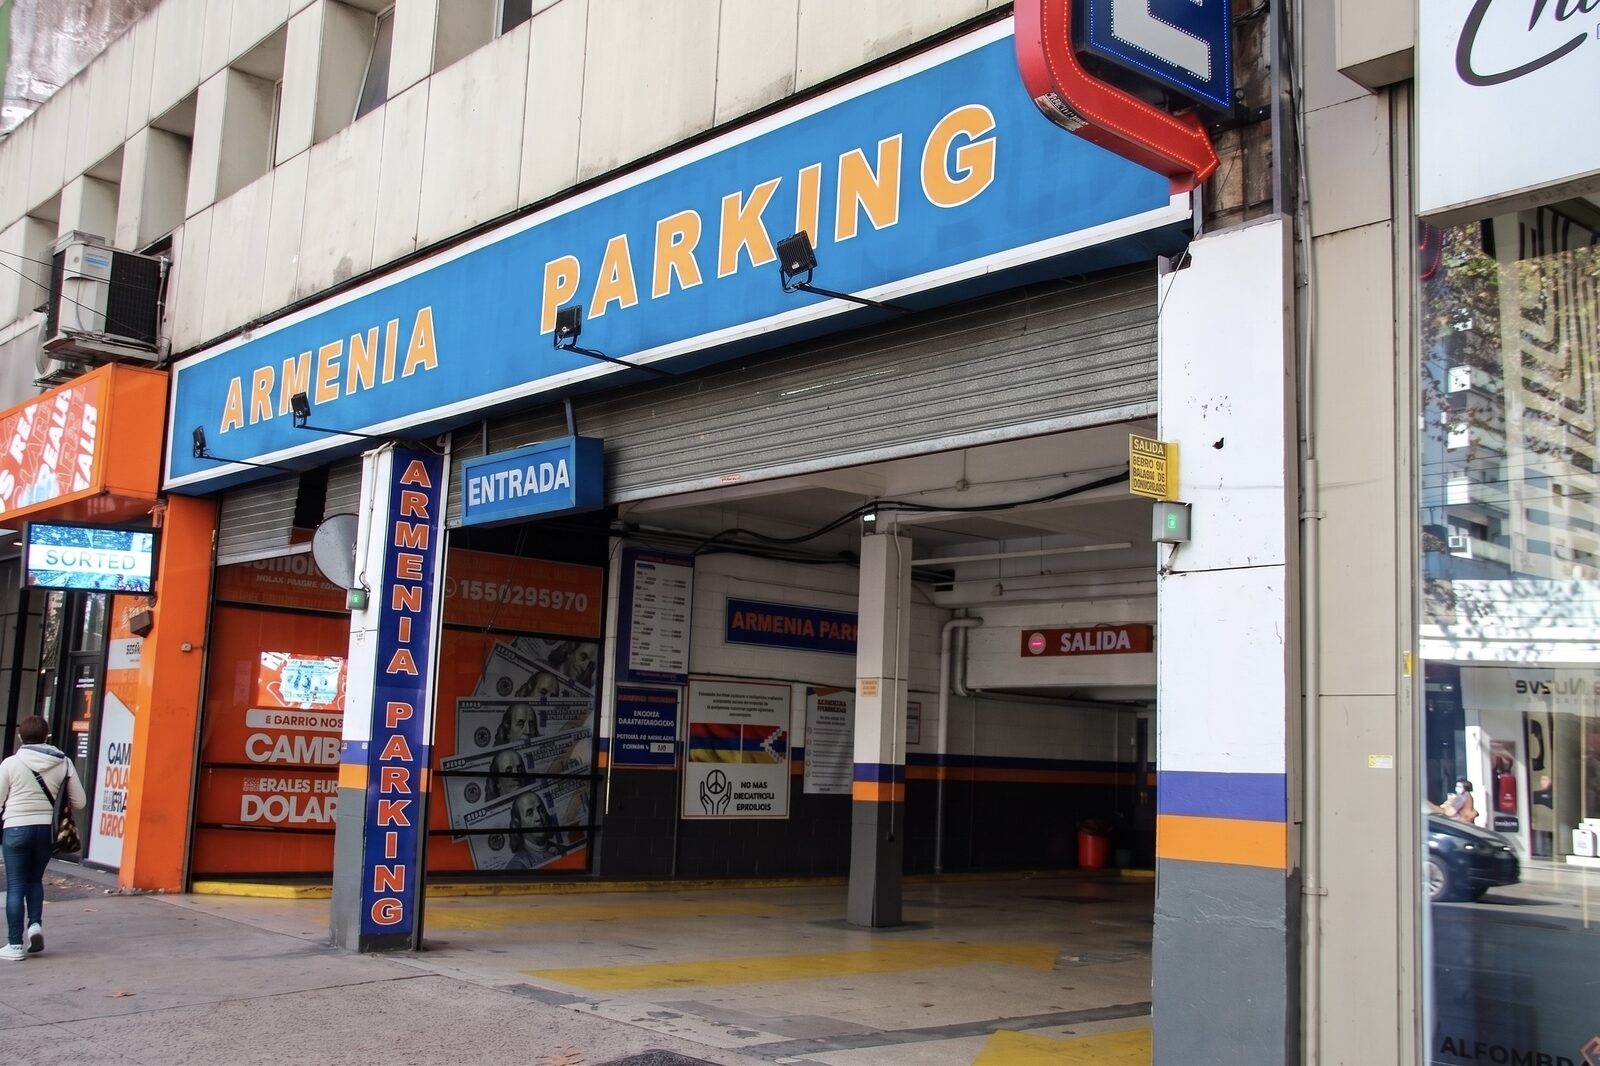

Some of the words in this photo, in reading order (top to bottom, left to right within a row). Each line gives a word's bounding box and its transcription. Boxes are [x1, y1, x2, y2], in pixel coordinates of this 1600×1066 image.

[219, 305, 439, 434] ARMENIA
[539, 103, 997, 336] PARKING
[1133, 439, 1164, 456] SALIDA
[468, 459, 571, 507] ENTRADA
[45, 549, 136, 570] SORTED
[386, 459, 432, 675] ARMENIA
[731, 610, 814, 637] ARMENIA
[1060, 629, 1131, 653] SALIDA
[107, 742, 131, 766] CAM
[245, 732, 341, 765] CAMB
[740, 781, 751, 789] NO
[752, 781, 768, 789] MAS
[240, 794, 338, 823] DOLAR
[370, 701, 414, 926] PARKING
